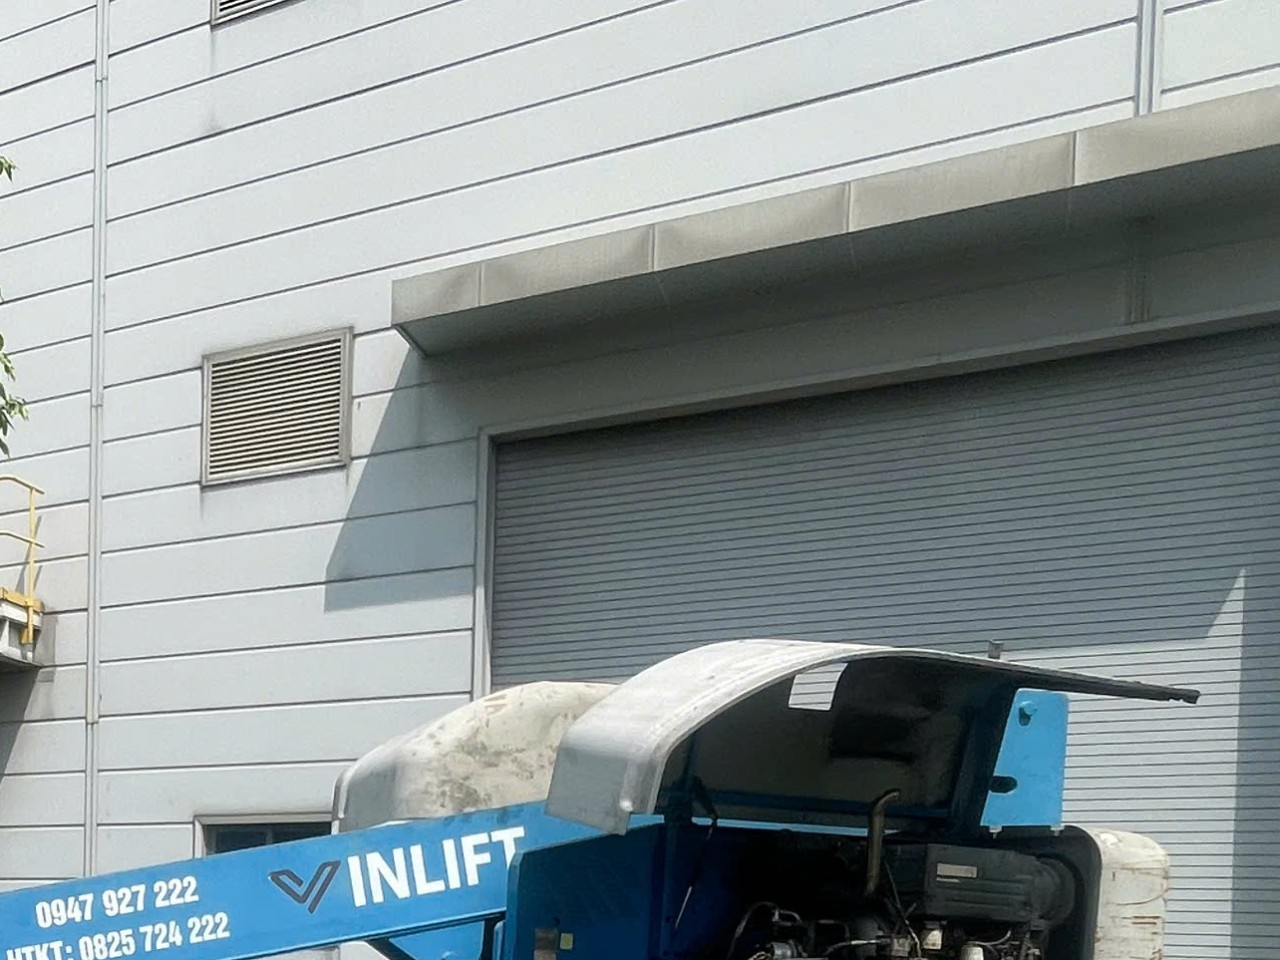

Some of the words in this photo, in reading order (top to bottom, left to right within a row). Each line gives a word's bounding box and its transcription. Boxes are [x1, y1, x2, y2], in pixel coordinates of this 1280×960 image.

[35, 893, 94, 928] 0947
[102, 884, 146, 917] 927
[153, 876, 199, 908] 222
[139, 921, 182, 952] 724
[187, 912, 230, 944] 222
